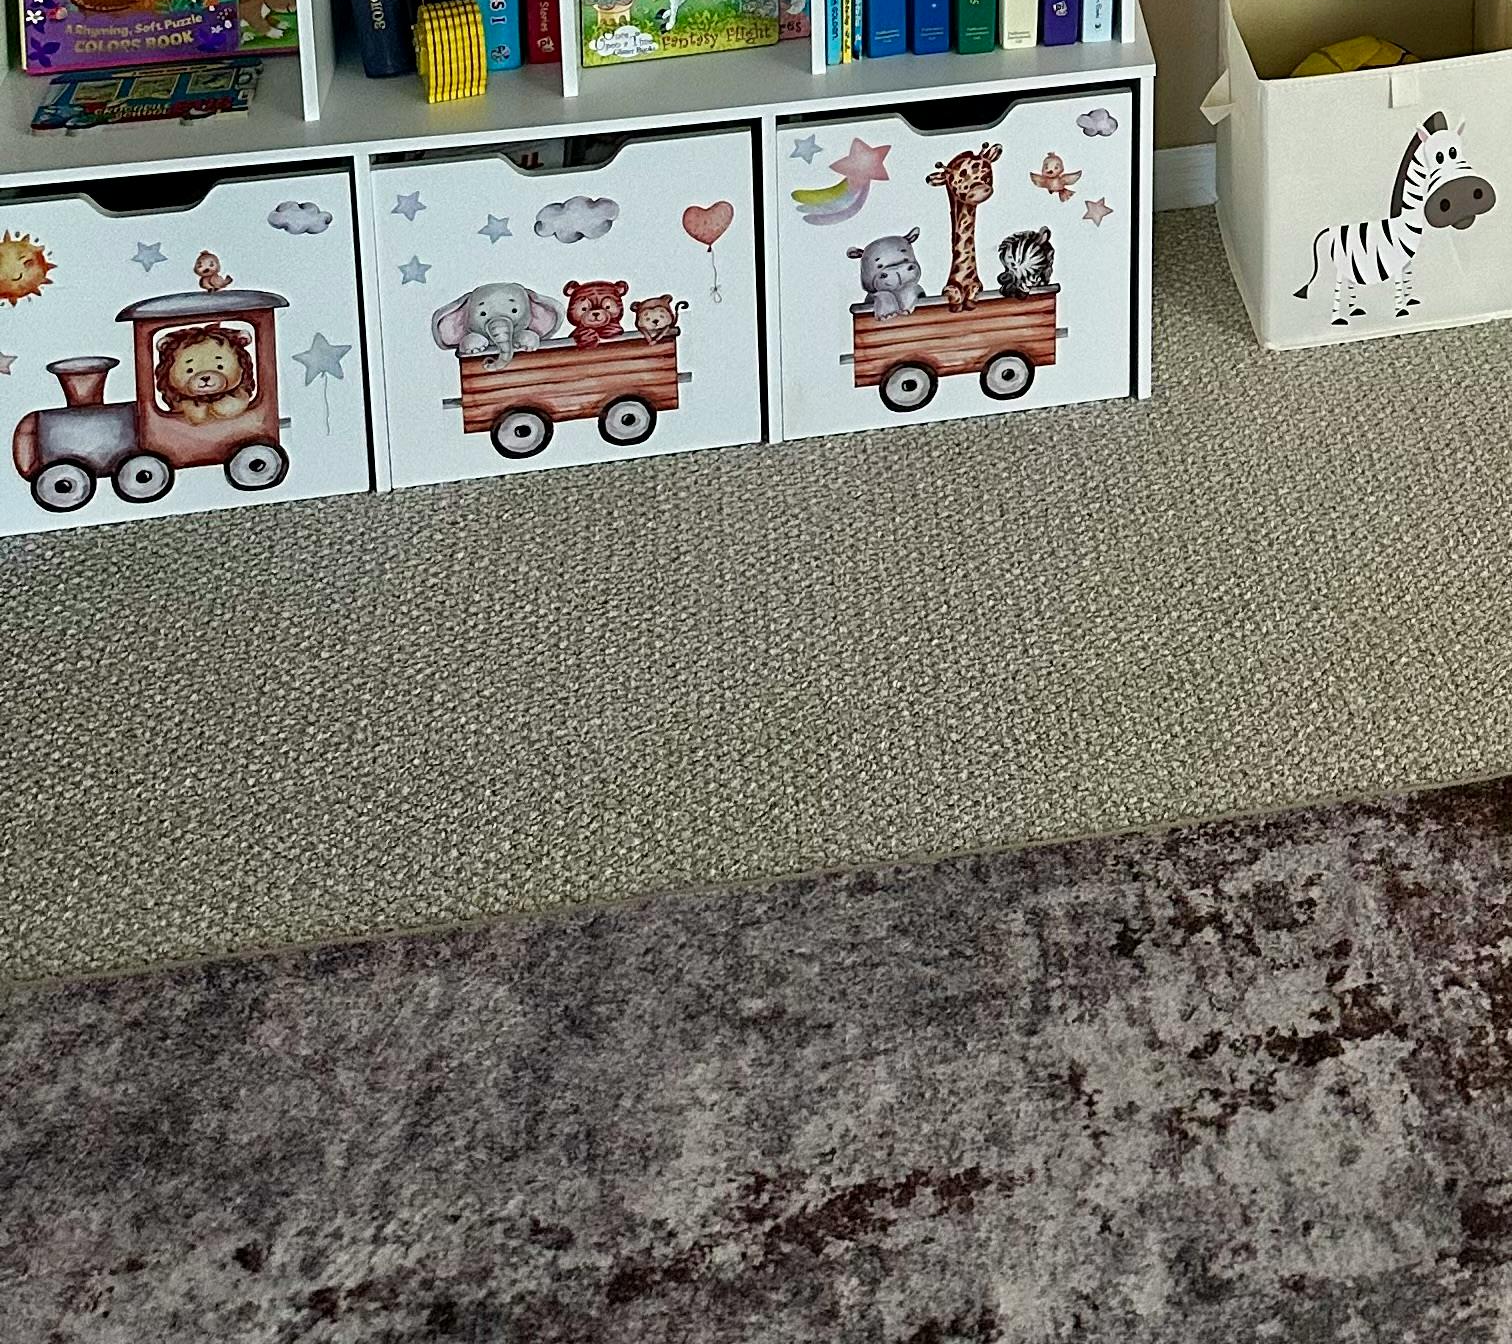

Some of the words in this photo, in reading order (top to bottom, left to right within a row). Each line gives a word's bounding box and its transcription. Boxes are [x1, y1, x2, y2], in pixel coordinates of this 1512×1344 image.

[135, 21, 162, 33] Soft
[165, 13, 202, 30] Puzzle
[539, 2, 549, 32] Stories
[74, 39, 142, 54] COLORS
[145, 30, 194, 49] BOOK
[661, 34, 718, 51] Fantasy
[726, 25, 771, 44] Flight
